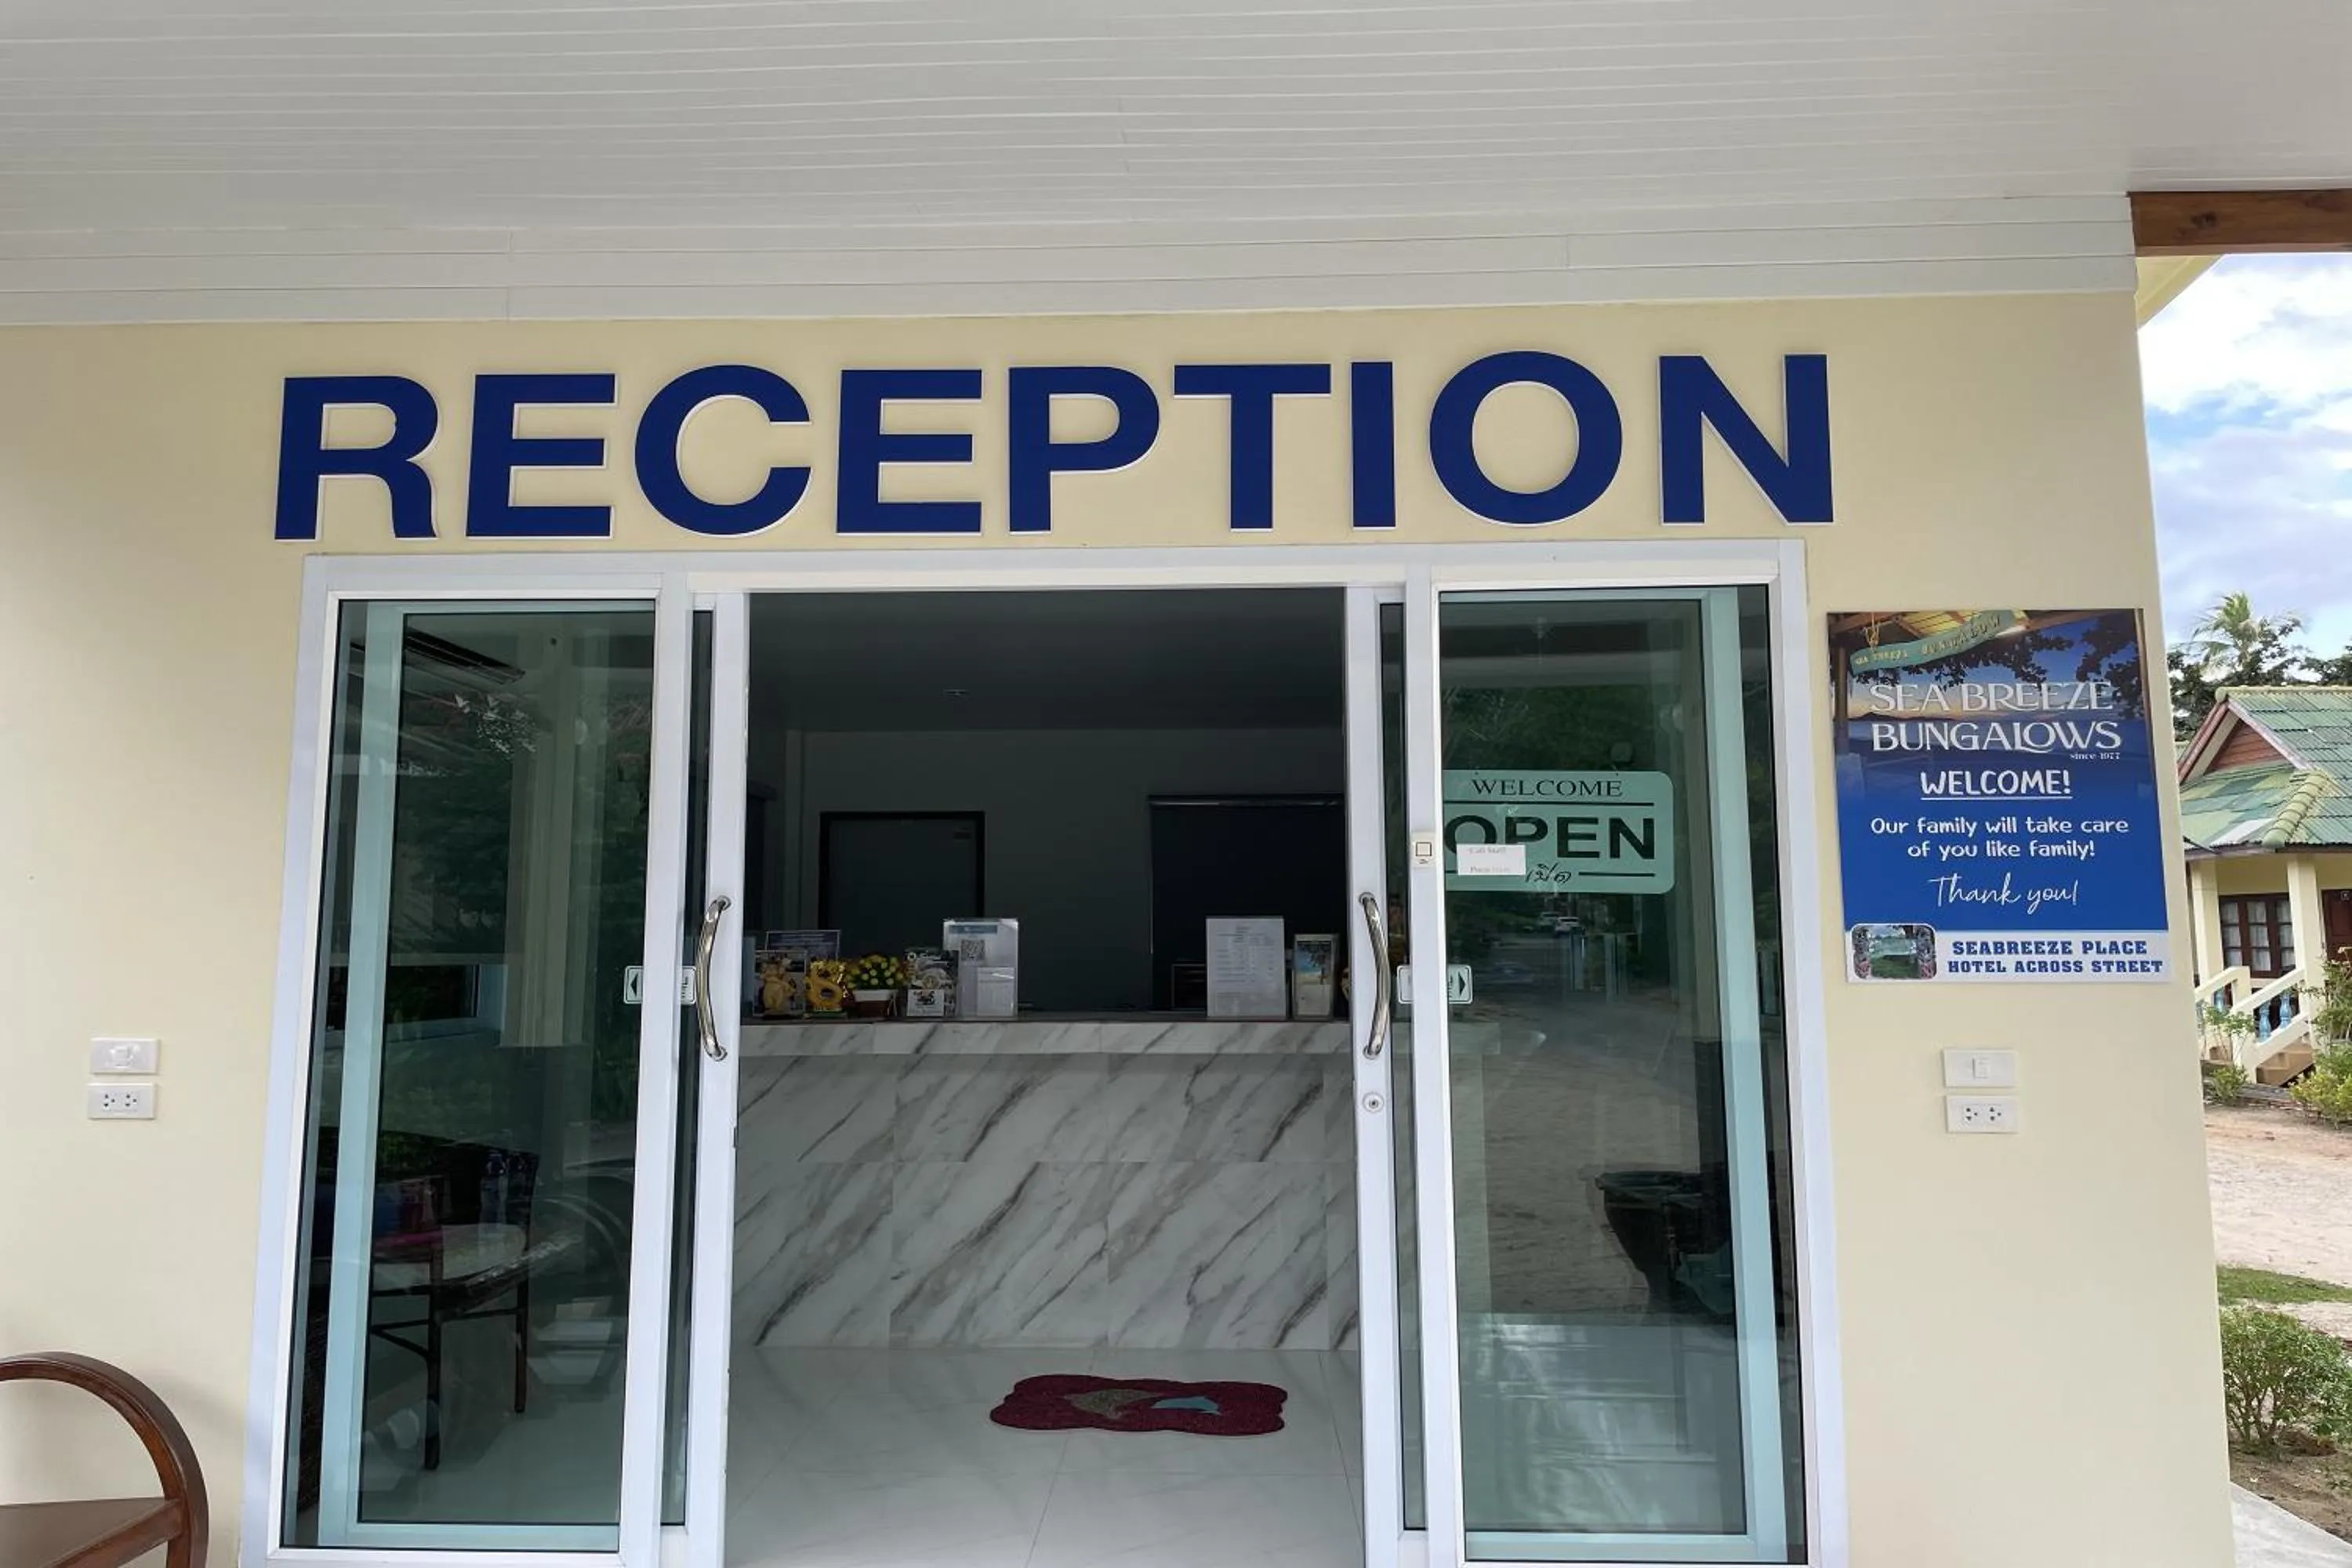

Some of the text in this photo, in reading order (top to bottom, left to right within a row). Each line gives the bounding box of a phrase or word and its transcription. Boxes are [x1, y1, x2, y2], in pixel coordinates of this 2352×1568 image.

[274, 352, 1834, 541] RECEPTION
[1870, 682, 2113, 711] SEA BREEZE
[1872, 720, 2122, 753] BUNGALOWS
[1471, 779, 1624, 797] WELCOME
[1920, 769, 2071, 795] WELCOME!
[1444, 815, 1656, 860] OPEN
[1871, 817, 2129, 837] Our family will take care
[1907, 840, 2095, 861] of you like family!
[1927, 872, 2078, 915] Thank you!
[1952, 941, 2147, 955] SEABREEZE PLACE
[1947, 960, 2163, 973] HOTEL ACROSS STREET
